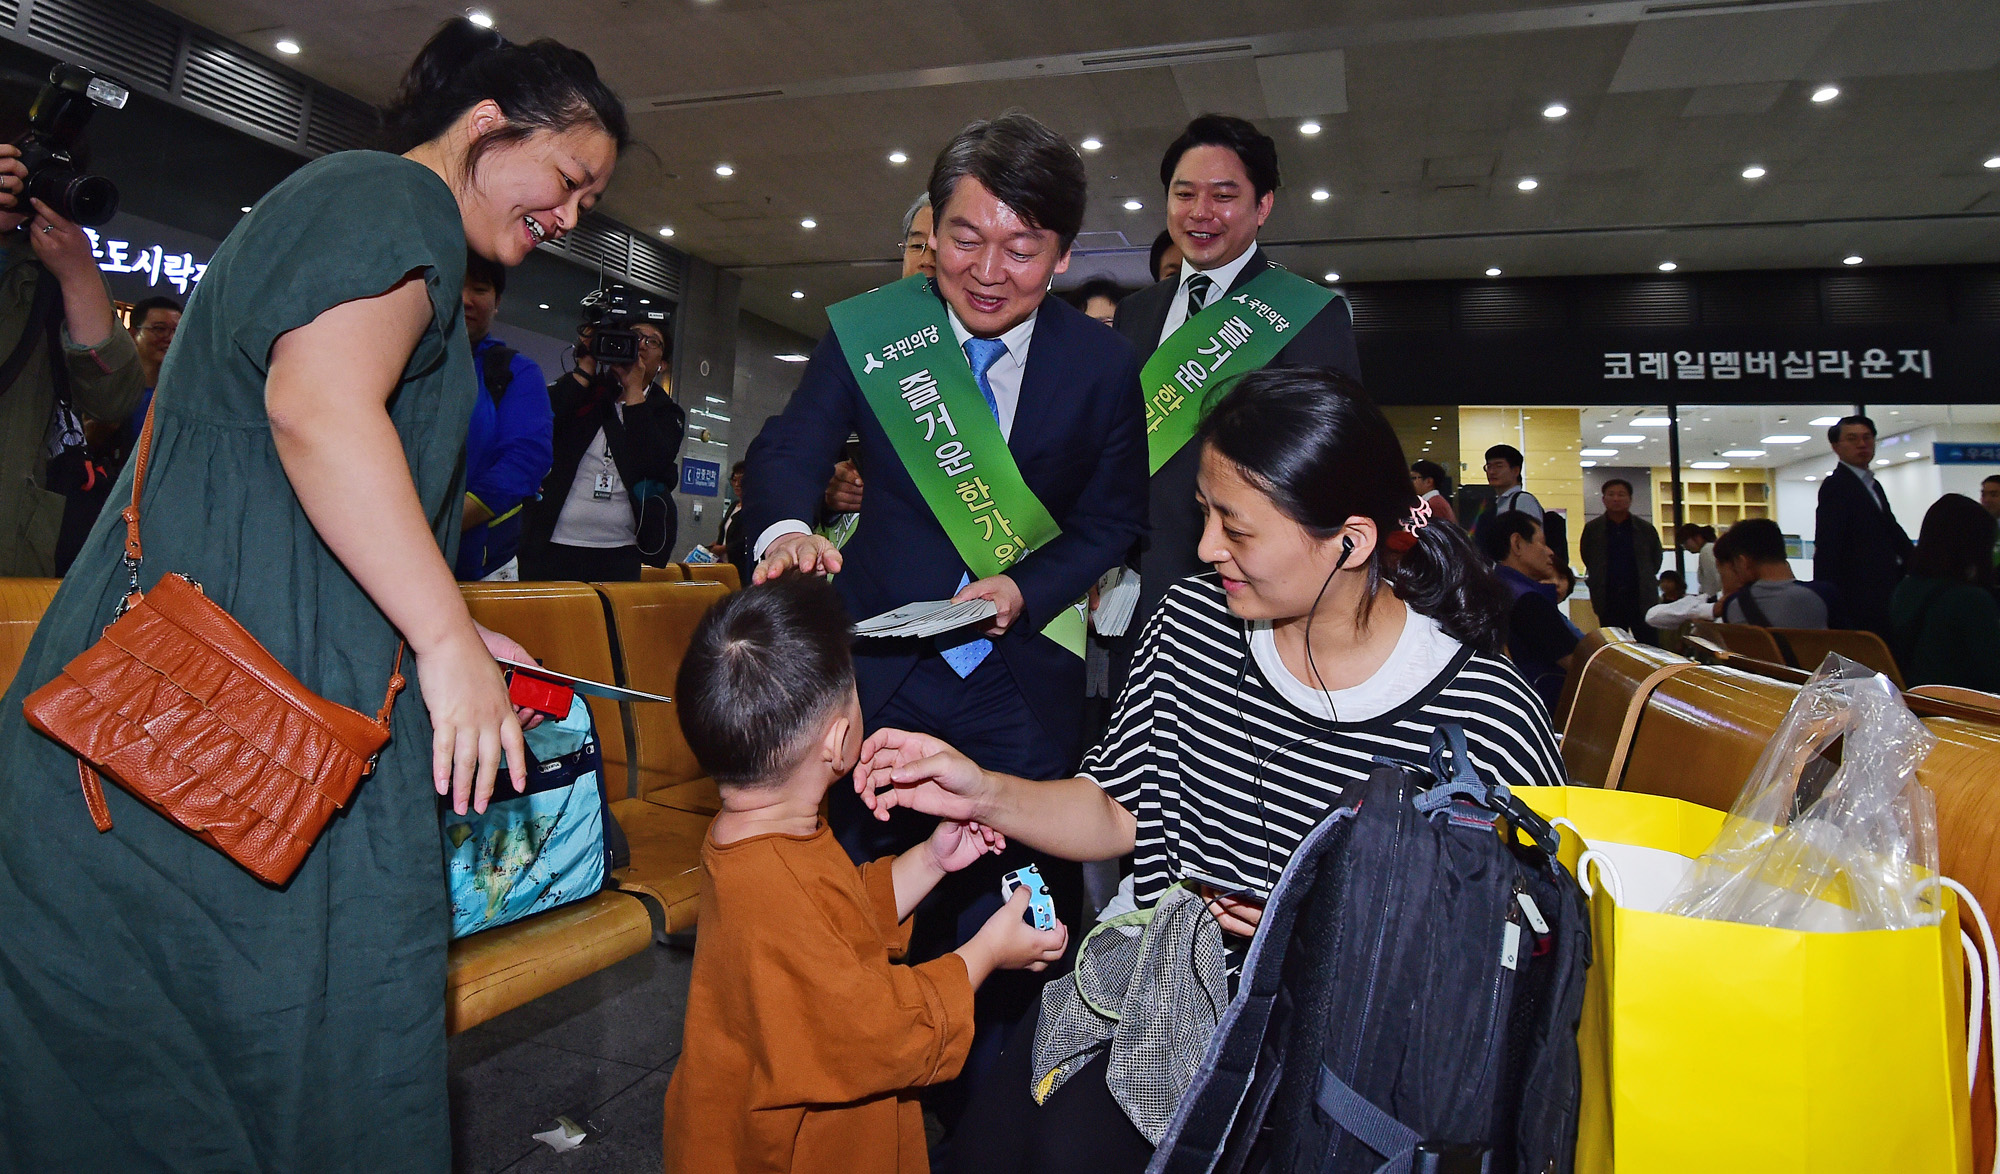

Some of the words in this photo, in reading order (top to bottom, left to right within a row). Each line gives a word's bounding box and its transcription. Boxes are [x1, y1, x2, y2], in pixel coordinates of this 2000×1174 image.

[1248, 298, 1291, 333] 국민의당
[882, 324, 940, 362] 국민의당
[1174, 315, 1254, 393] 즐거운
[1603, 348, 1932, 380] 코레일멤버십라운지
[899, 368, 975, 478] 즐거운
